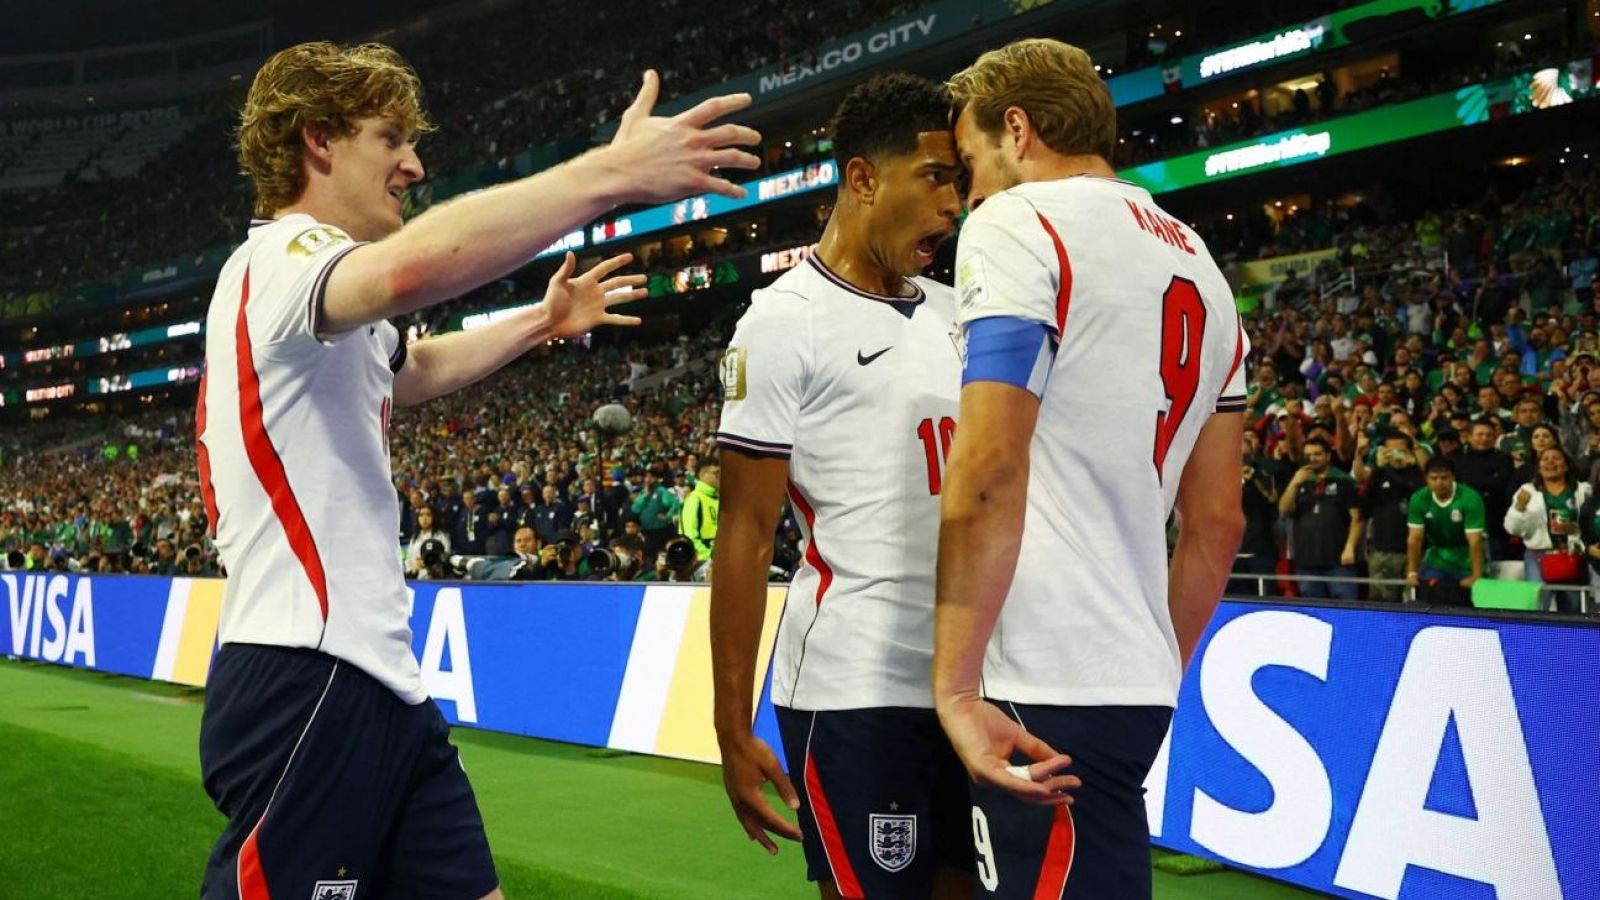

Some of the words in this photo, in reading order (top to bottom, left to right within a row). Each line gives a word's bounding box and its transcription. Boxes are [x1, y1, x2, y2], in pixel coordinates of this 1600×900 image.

[760, 42, 864, 93] MEXICO
[867, 14, 937, 53] CITY
[758, 163, 833, 200] MEXICO
[761, 243, 819, 273] MEXI
[1124, 198, 1197, 256] KANE
[1153, 274, 1207, 488] 9
[2, 574, 96, 667] VISA
[1142, 610, 1564, 900] SA
[971, 805, 999, 892] 9
